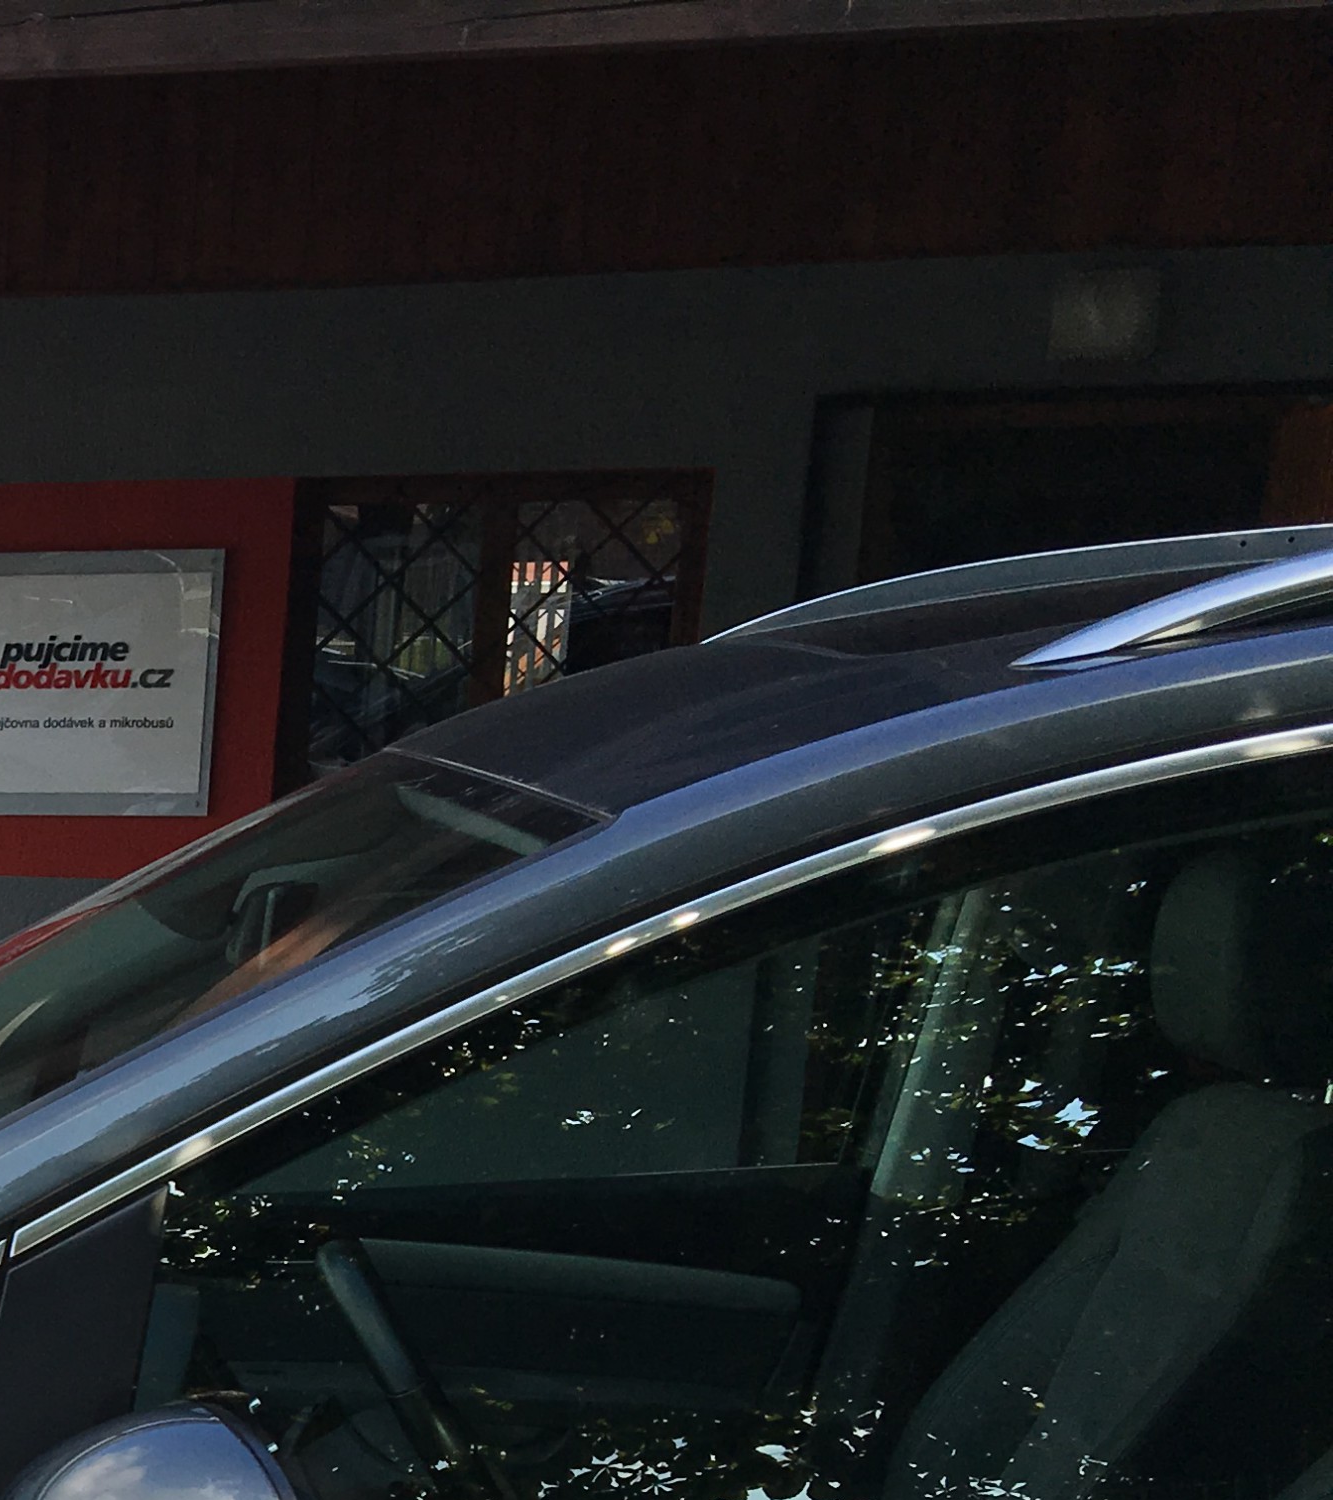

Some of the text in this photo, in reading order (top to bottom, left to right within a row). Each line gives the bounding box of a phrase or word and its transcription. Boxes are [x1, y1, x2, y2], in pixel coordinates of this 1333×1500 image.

[0, 635, 130, 669] pujcime
[43, 716, 94, 729] dodávek
[98, 720, 106, 729] a
